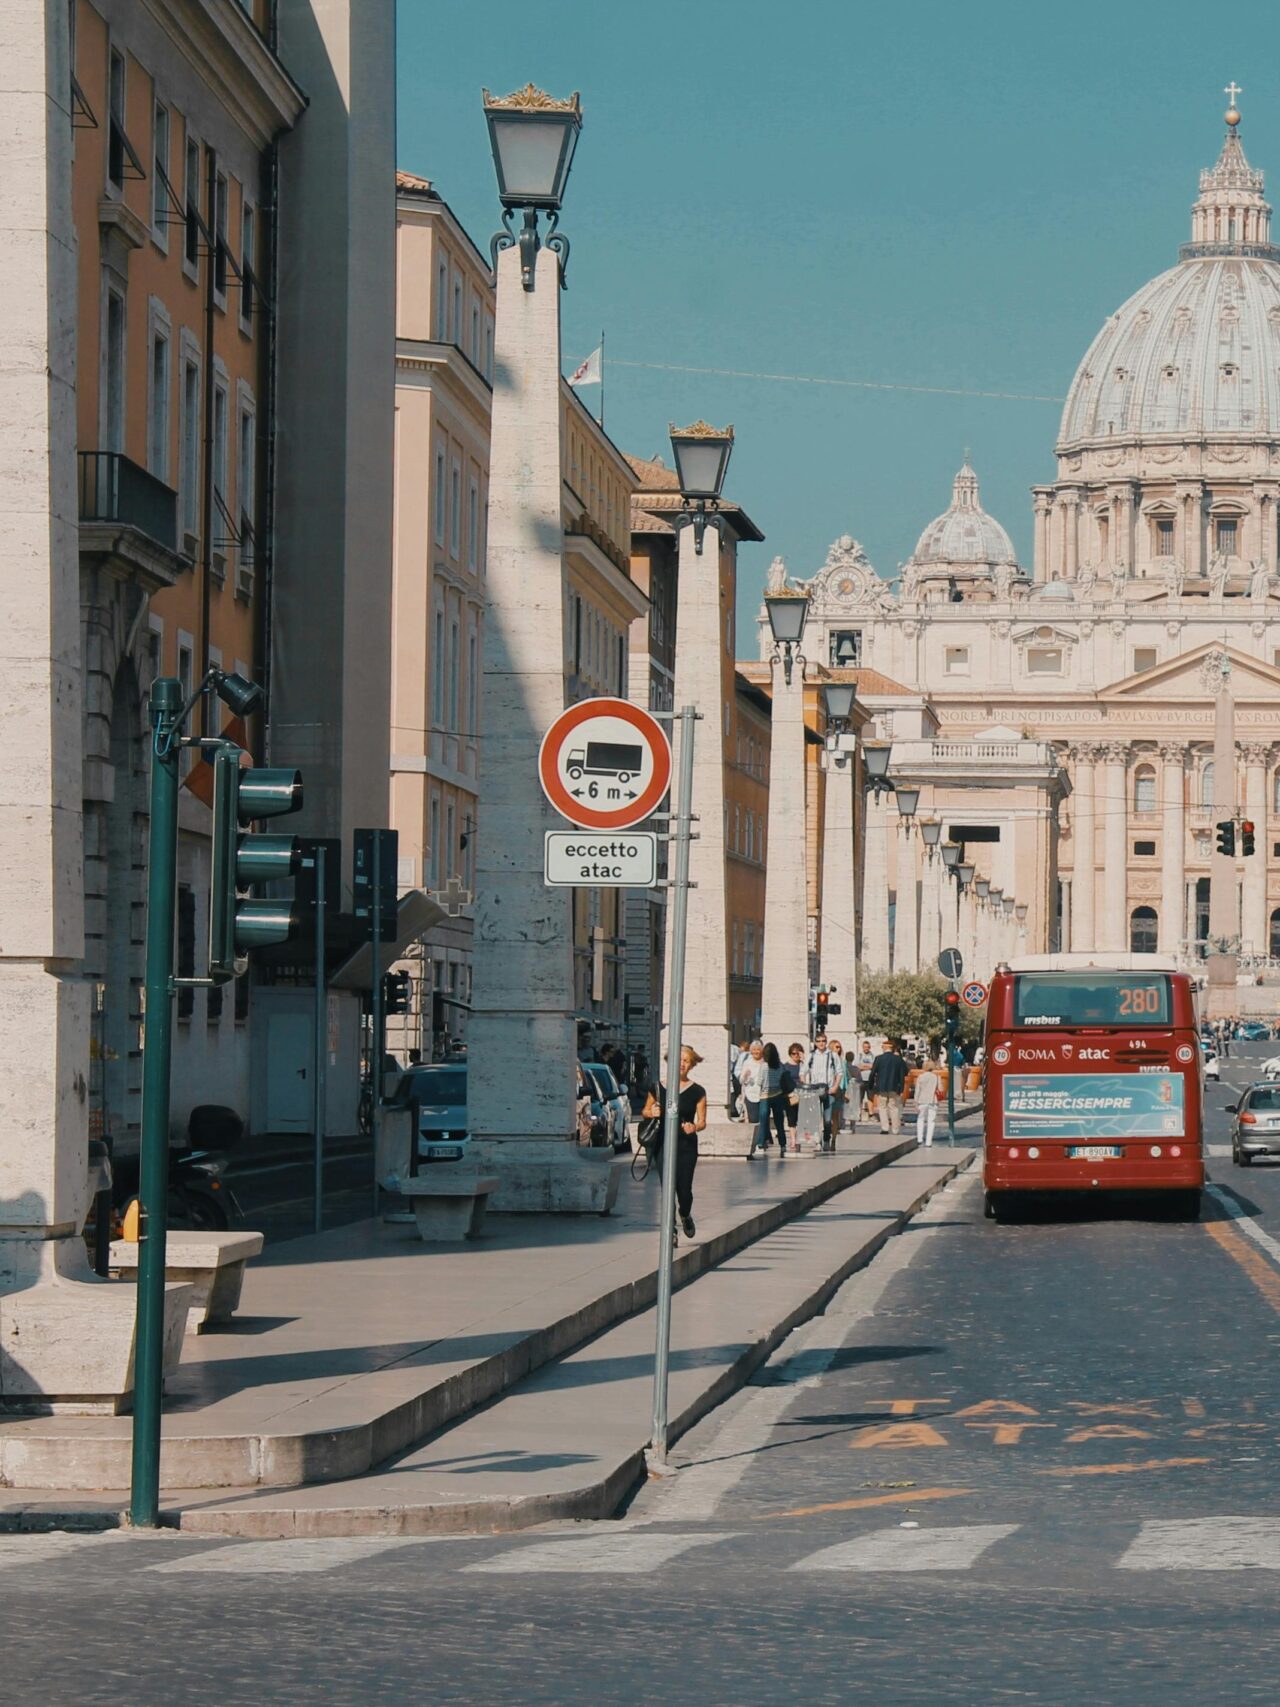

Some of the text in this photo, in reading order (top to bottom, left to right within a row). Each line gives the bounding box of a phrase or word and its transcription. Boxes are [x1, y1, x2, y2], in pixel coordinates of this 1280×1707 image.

[940, 711, 988, 721] NOREM
[993, 712, 1062, 721] PRINCIPIS
[588, 781, 620, 800] 6 m
[565, 842, 638, 858] eccetto
[580, 863, 622, 878] atac
[1119, 988, 1159, 1015] 280
[1129, 1040, 1147, 1049] 494
[1018, 1046, 1110, 1060] ROMA atac
[1180, 1049, 1191, 1059] 80
[1043, 1091, 1069, 1099] maggio
[1009, 1097, 1133, 1110] #ESSERCISEMPRE
